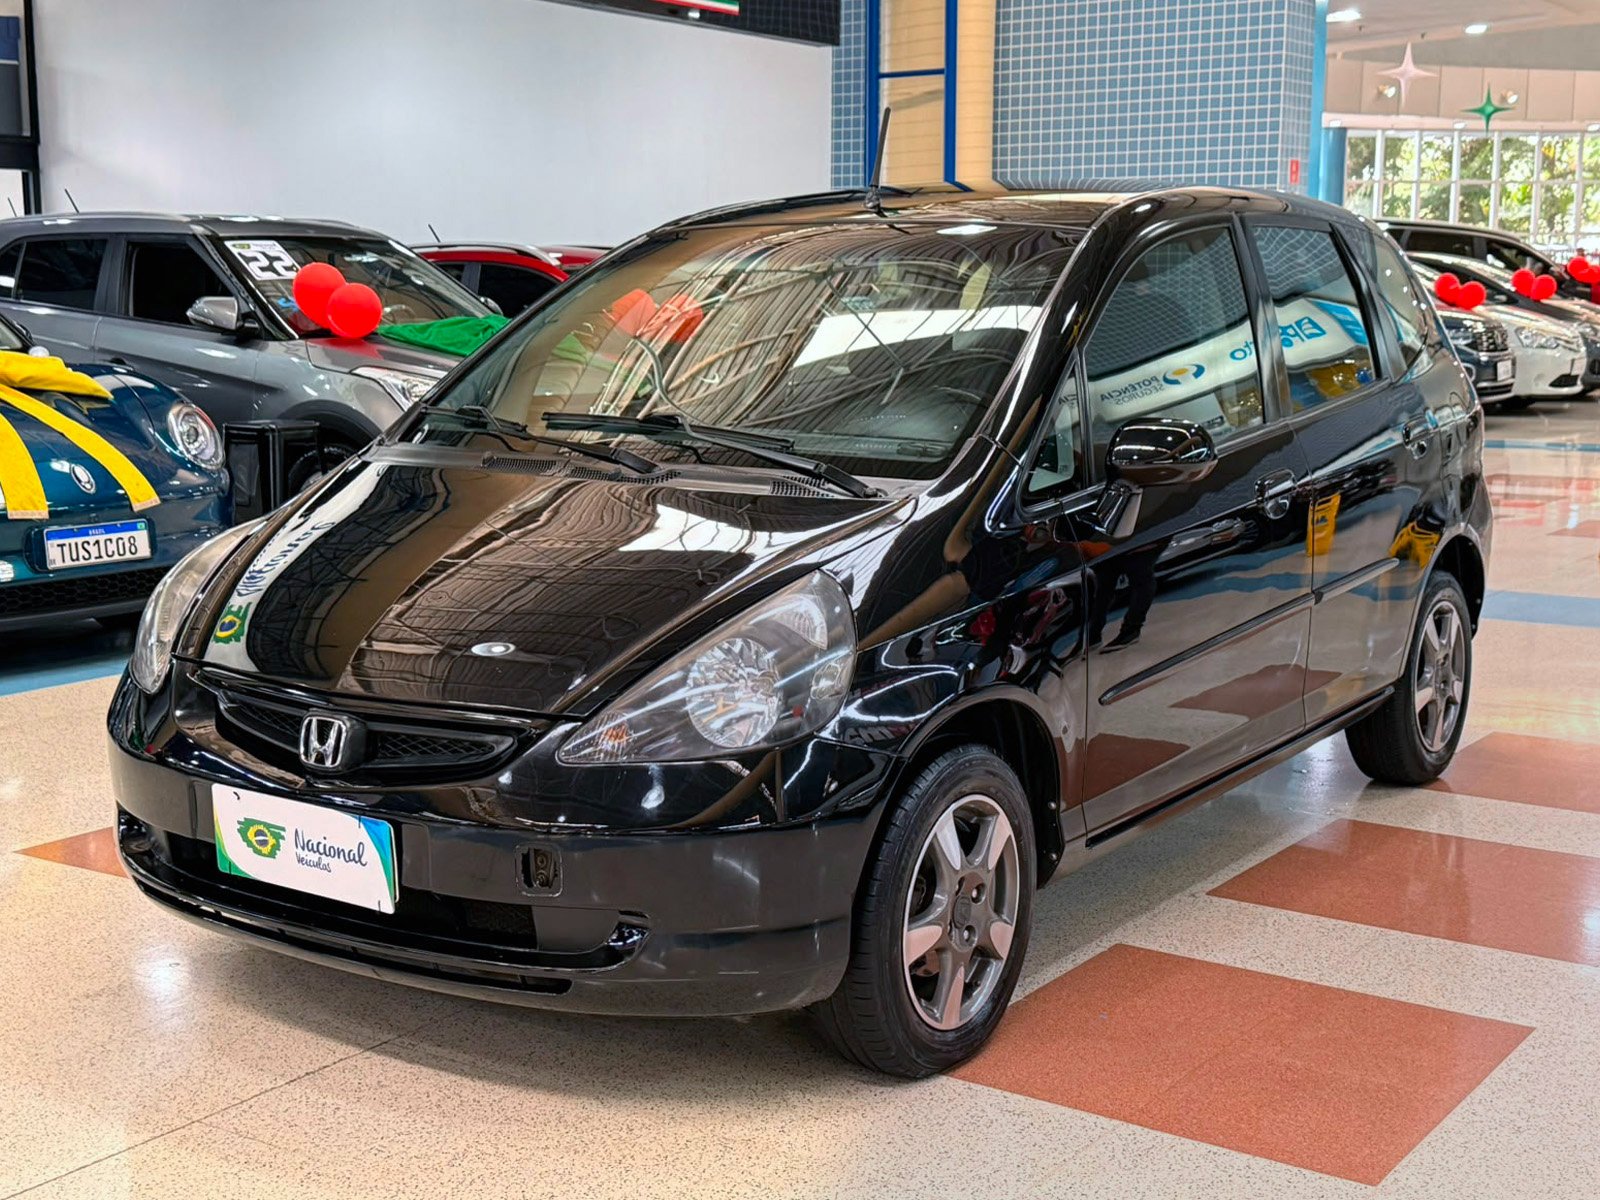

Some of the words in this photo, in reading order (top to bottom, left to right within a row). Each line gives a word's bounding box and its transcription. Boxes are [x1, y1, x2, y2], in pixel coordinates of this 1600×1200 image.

[239, 250, 299, 278] 22
[57, 535, 138, 564] TUS1C08
[295, 828, 368, 867] Nacional
